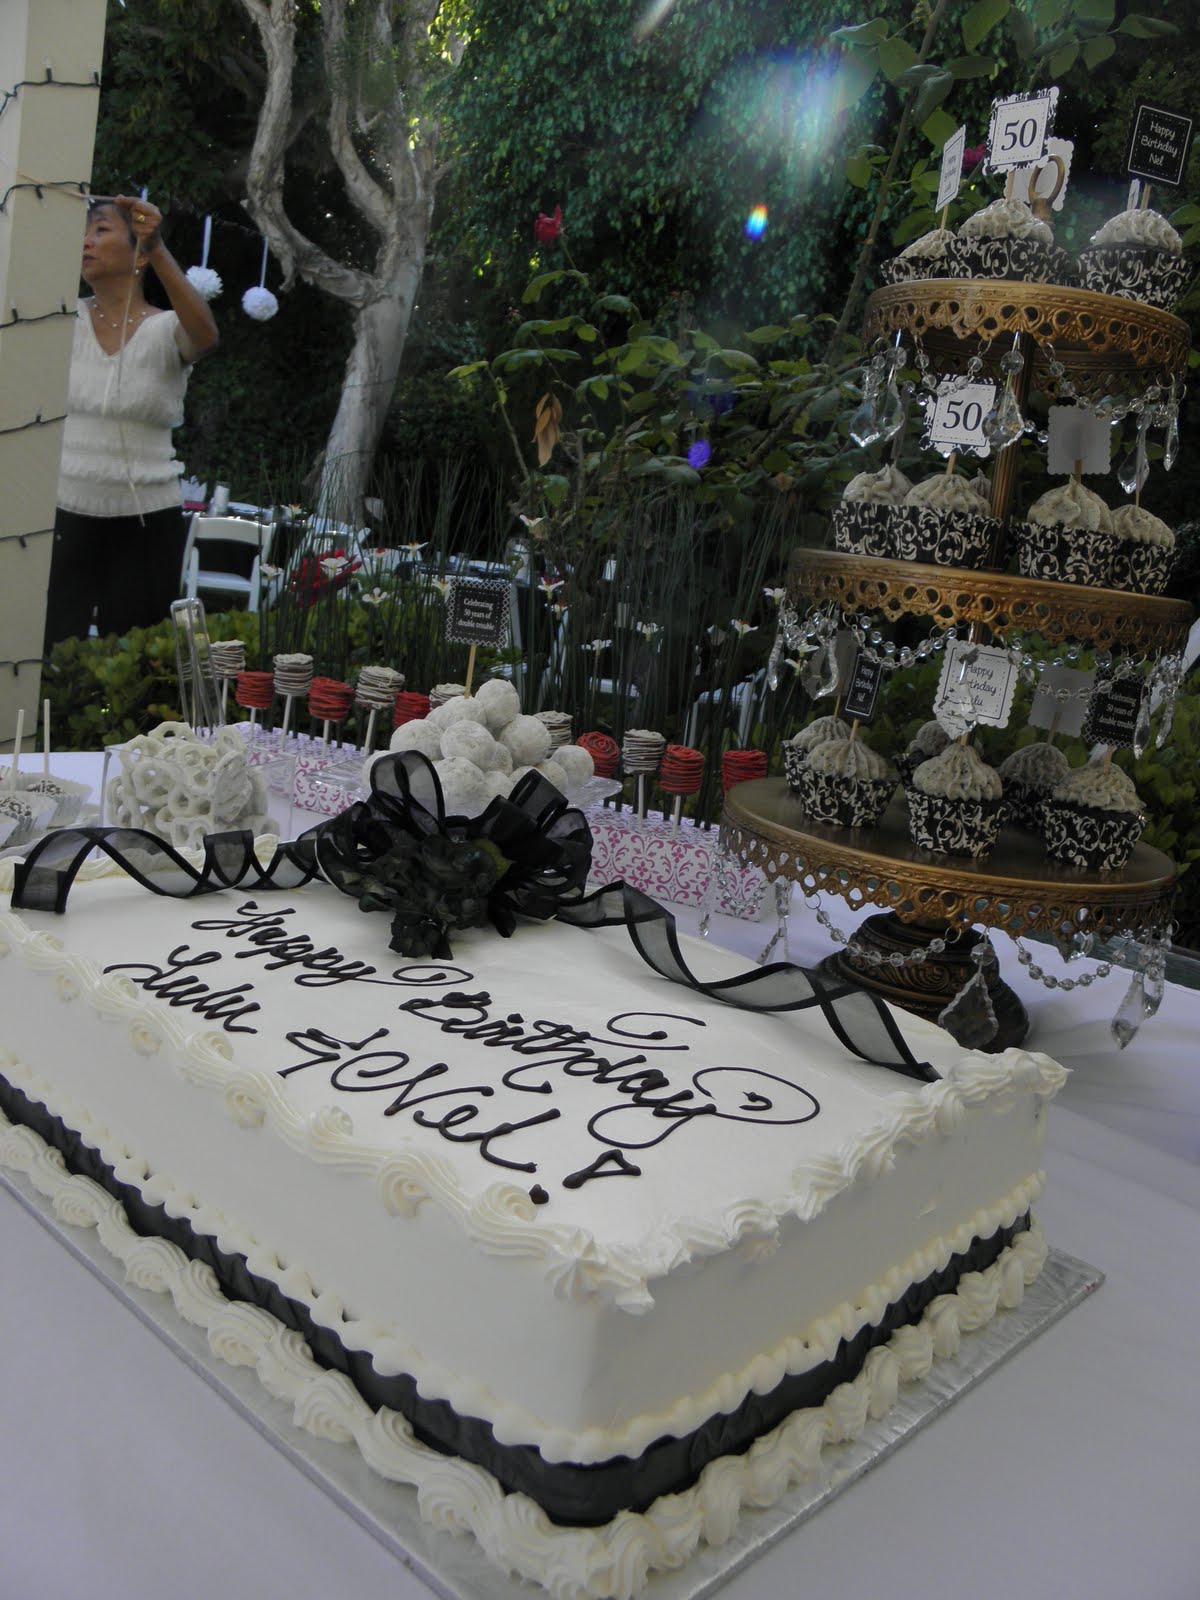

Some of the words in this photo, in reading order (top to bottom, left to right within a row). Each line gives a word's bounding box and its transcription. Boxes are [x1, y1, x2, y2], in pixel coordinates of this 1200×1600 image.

[1000, 118, 1038, 151] 50
[1150, 121, 1176, 140] Happy
[1141, 135, 1178, 158] Birthday
[1149, 153, 1164, 166] Nel
[942, 401, 984, 432] 50
[463, 598, 493, 611] Celebrating
[471, 611, 485, 619] years
[458, 619, 475, 628] double
[476, 622, 495, 630] trouble
[103, 944, 261, 1034] Lulu
[191, 900, 473, 987] Happy
[399, 991, 820, 1149] Birthday
